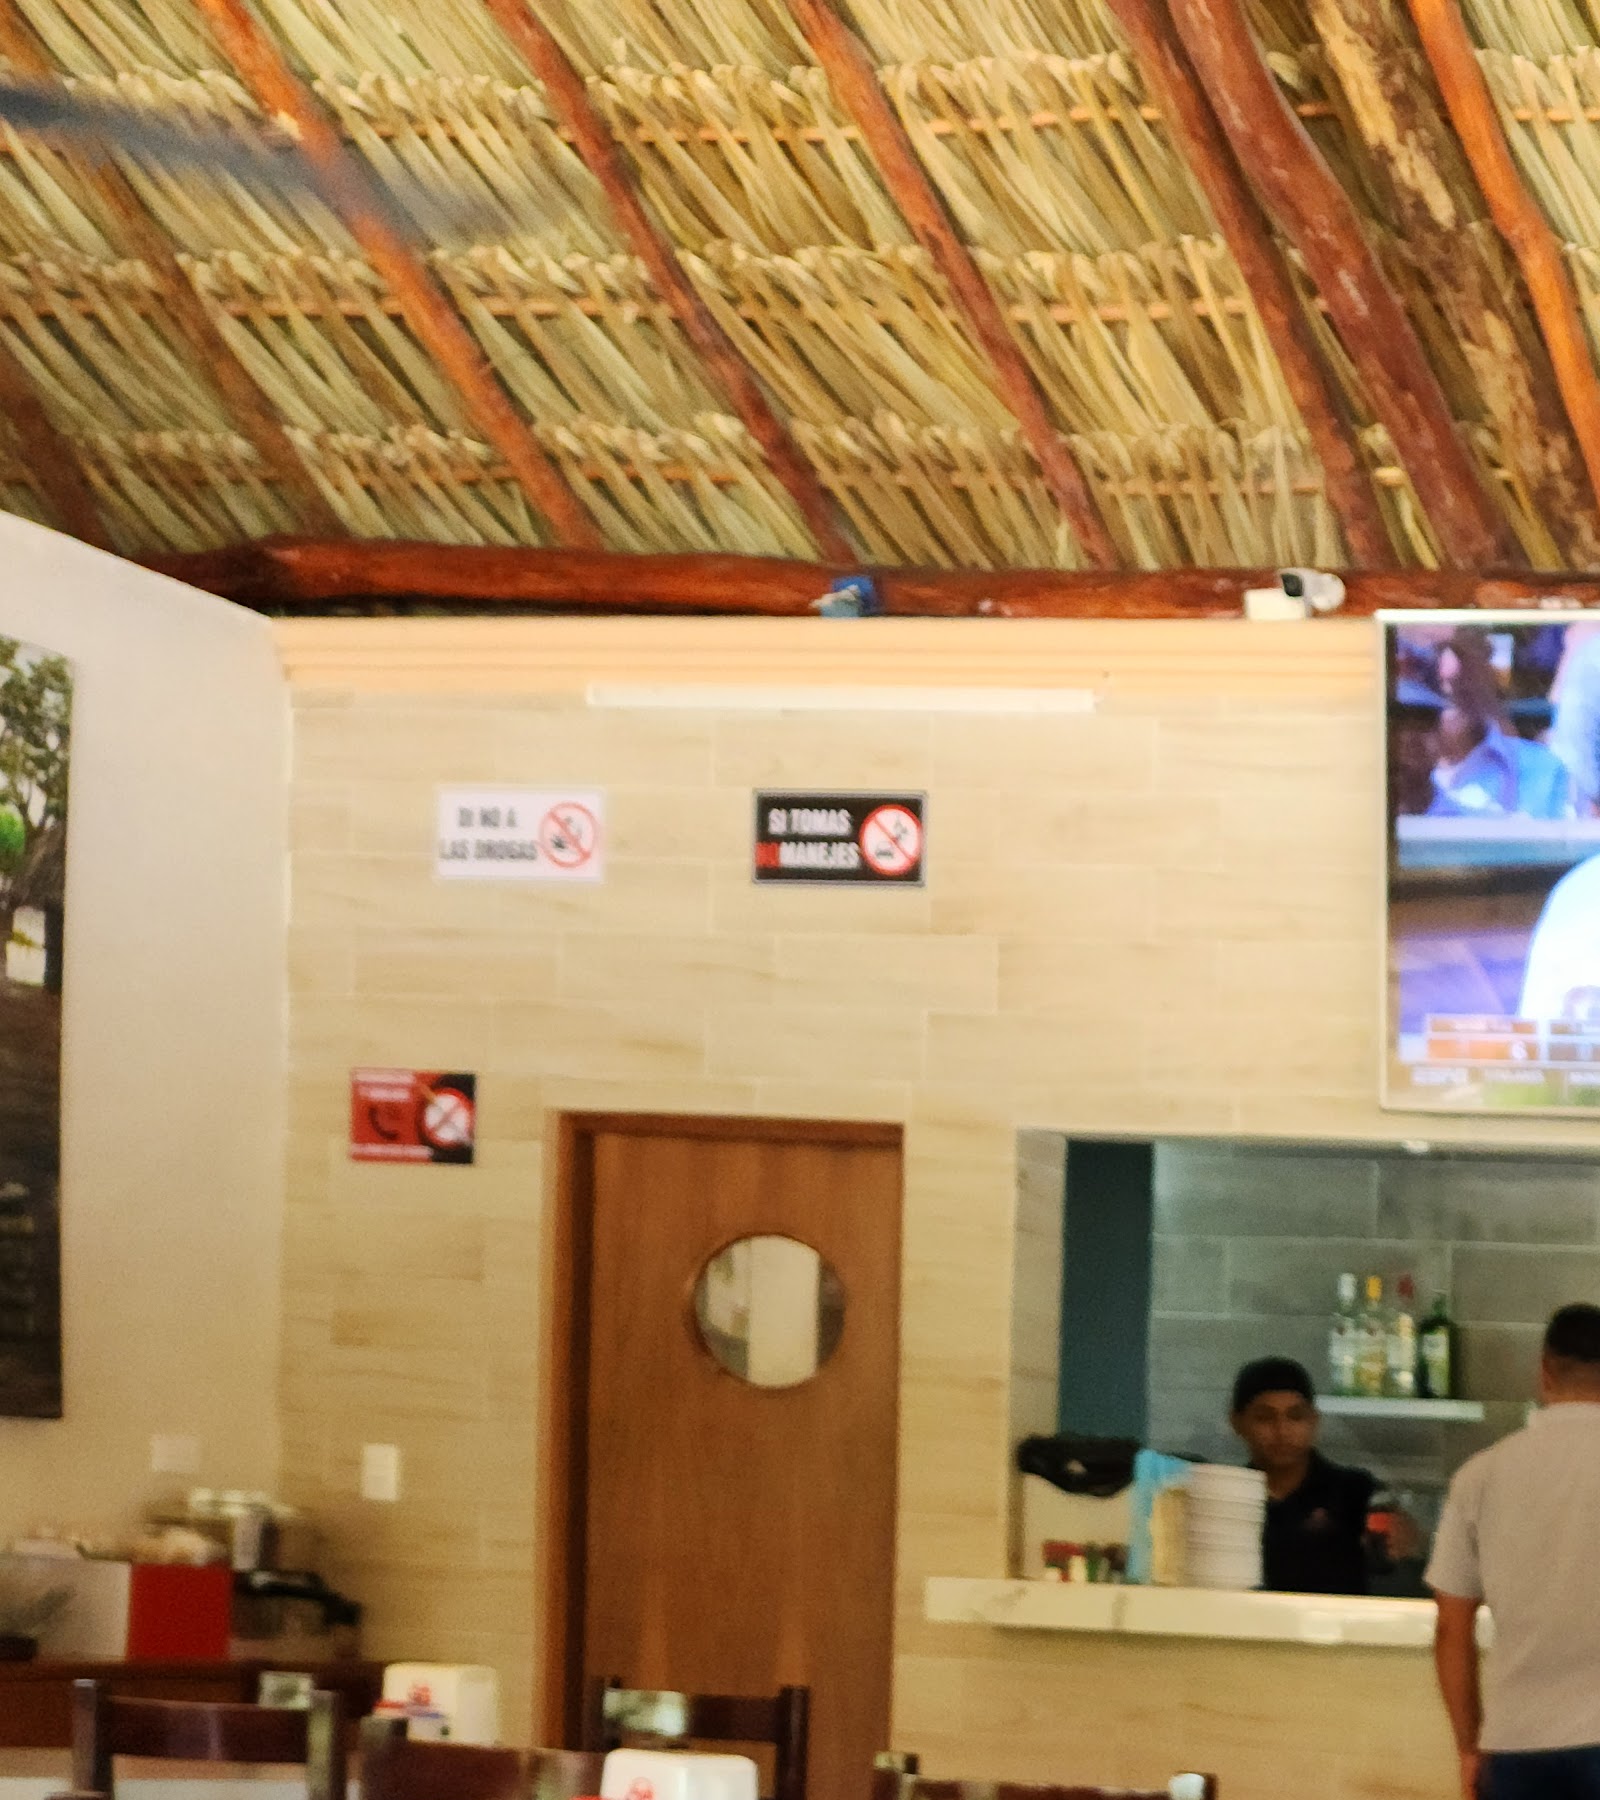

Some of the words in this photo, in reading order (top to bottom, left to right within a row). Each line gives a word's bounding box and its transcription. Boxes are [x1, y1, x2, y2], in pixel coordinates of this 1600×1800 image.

[768, 807, 788, 835] SI
[790, 808, 852, 836] TOMAS
[472, 838, 537, 862] DROGAS
[779, 840, 860, 869] MANEJES
